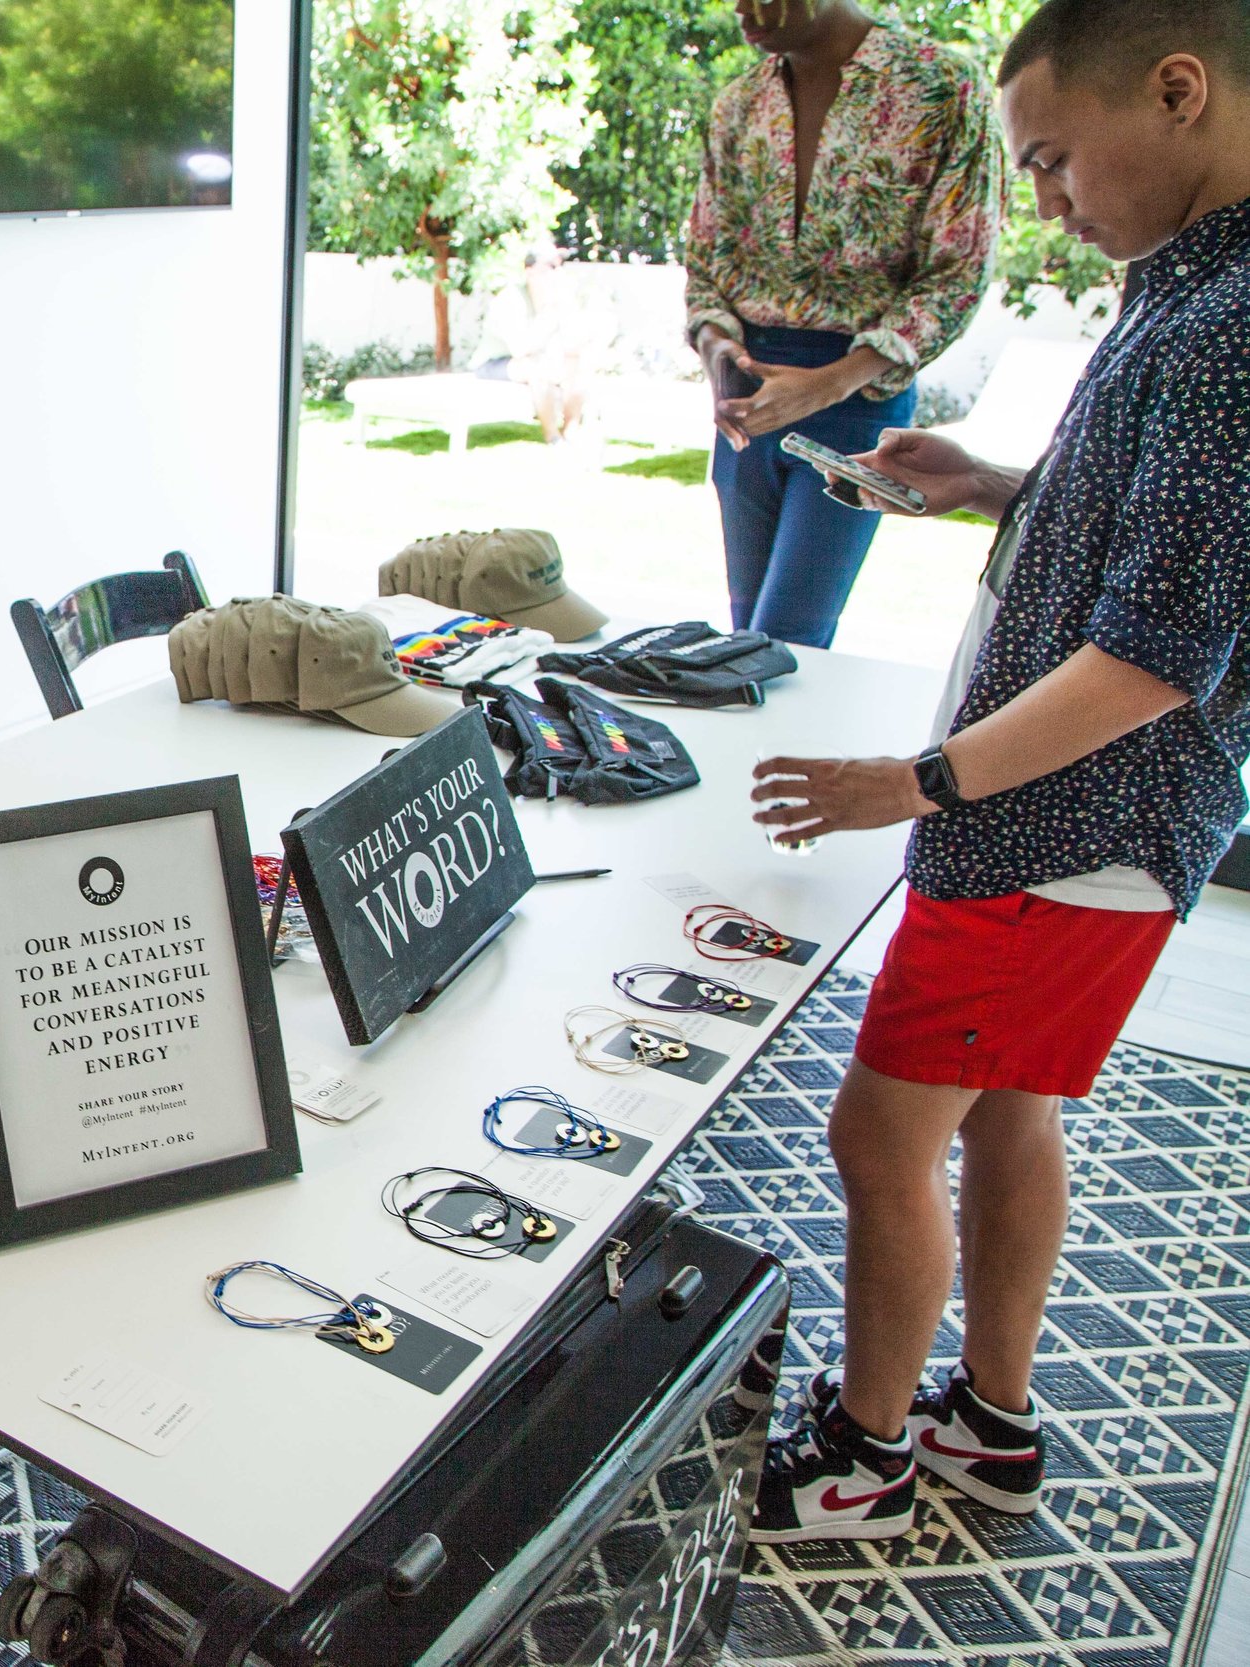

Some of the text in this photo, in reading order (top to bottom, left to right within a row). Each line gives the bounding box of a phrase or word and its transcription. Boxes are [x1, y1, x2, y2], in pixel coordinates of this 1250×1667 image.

[338, 757, 486, 887] WHAT'S YOUR
[82, 881, 124, 904] MyIntent
[355, 797, 506, 959] WORD?
[24, 914, 192, 956] OUR MISSION IS
[15, 937, 206, 984] TO BE A CATALYST
[19, 962, 211, 1009] FOR MEANINGFUL
[32, 987, 206, 1033] CONVERSATIONS
[47, 1014, 200, 1056] AND POSITIVE
[84, 1044, 169, 1075] ENERGY
[78, 1082, 184, 1111] SHARE YOUR STORY
[81, 1098, 188, 1129] @MyIntent #MyIntent
[657, 1467, 743, 1612] YOUR
